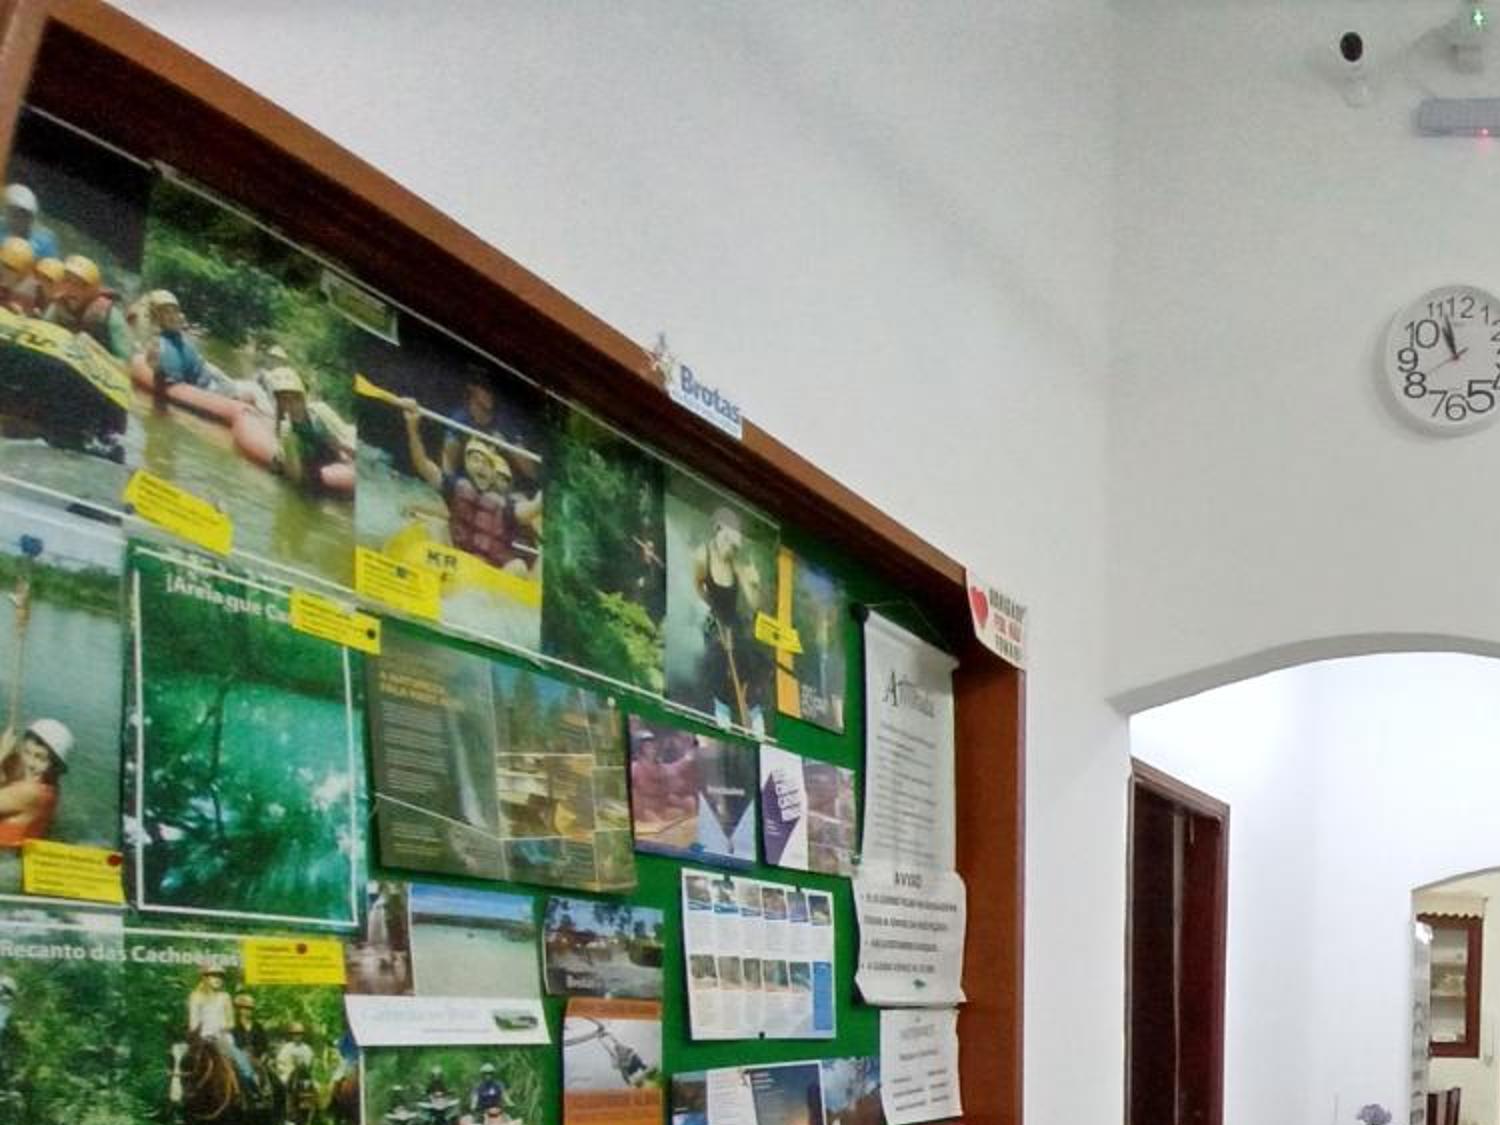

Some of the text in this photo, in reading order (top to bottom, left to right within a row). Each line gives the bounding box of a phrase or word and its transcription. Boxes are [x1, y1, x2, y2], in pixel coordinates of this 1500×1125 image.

[1427, 302, 1443, 318] 11
[1446, 296, 1475, 319] 12
[1480, 305, 1489, 325] 1
[1404, 319, 1440, 348] 10
[1397, 347, 1418, 372] 9
[681, 365, 740, 423] Brotas
[1404, 371, 1427, 399] 8
[1467, 379, 1495, 414] 5
[1428, 389, 1448, 417] 7
[1445, 394, 1467, 421] 6
[0, 939, 86, 960] Recanto
[90, 943, 127, 961] das
